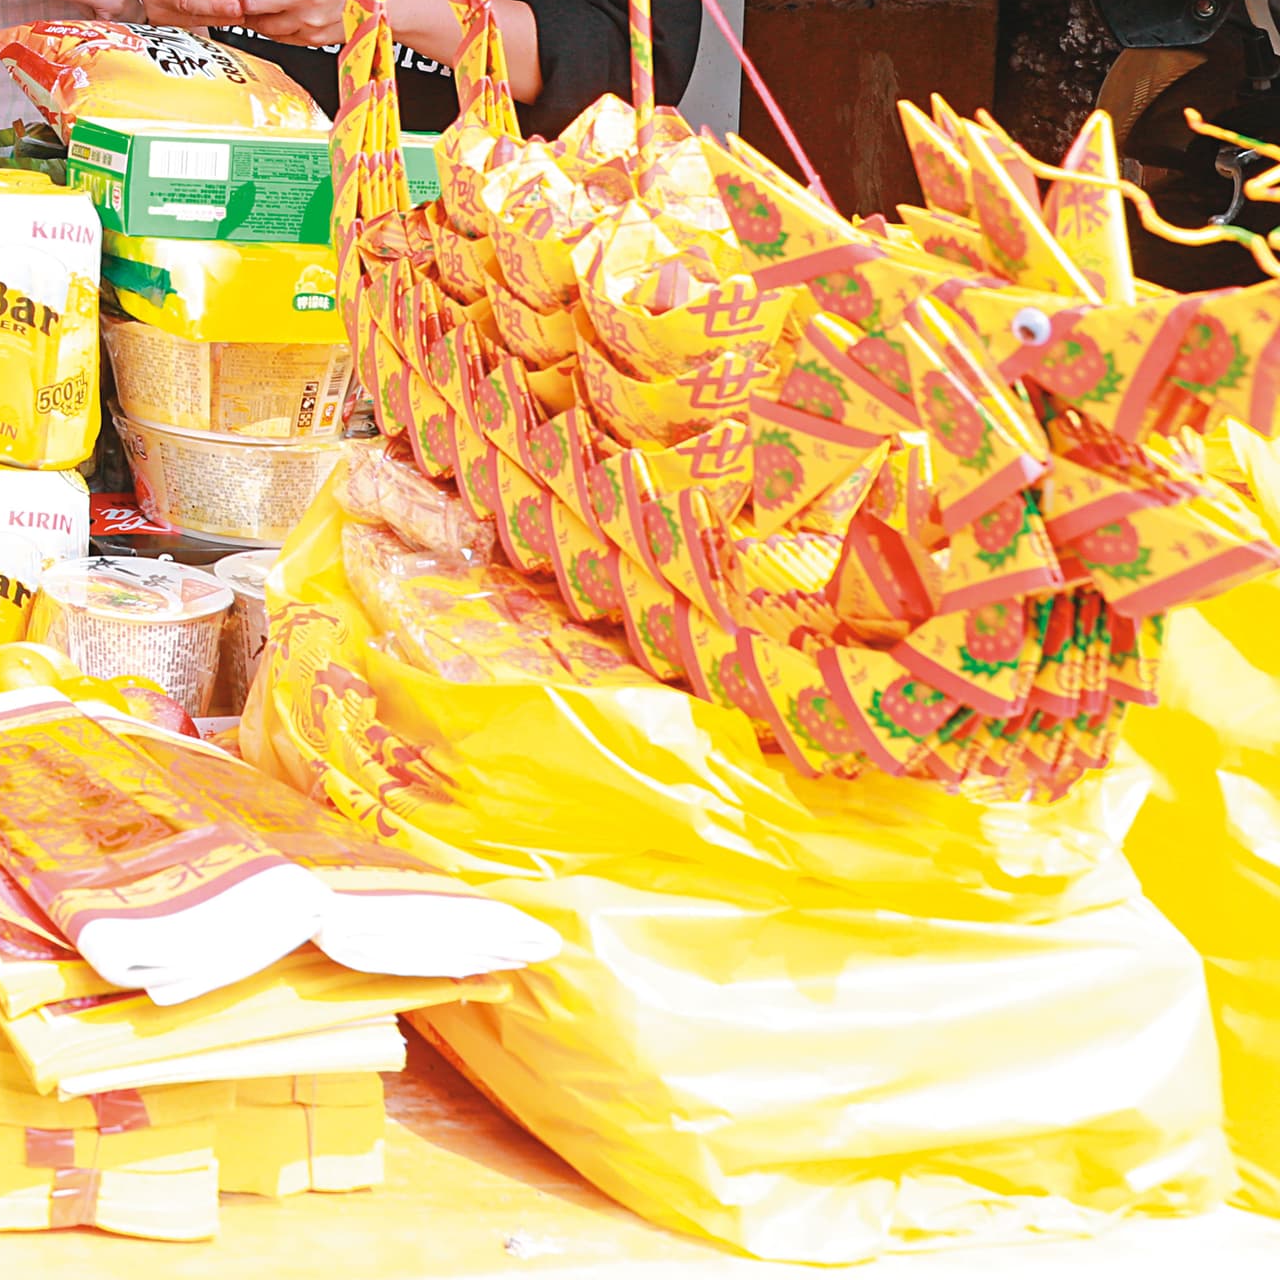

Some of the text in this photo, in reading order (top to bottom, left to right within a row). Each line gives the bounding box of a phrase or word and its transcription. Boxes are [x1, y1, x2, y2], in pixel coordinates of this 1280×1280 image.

[32, 220, 95, 246] KIRIN
[687, 282, 782, 338] 世
[8, 510, 74, 535] KIRIN
